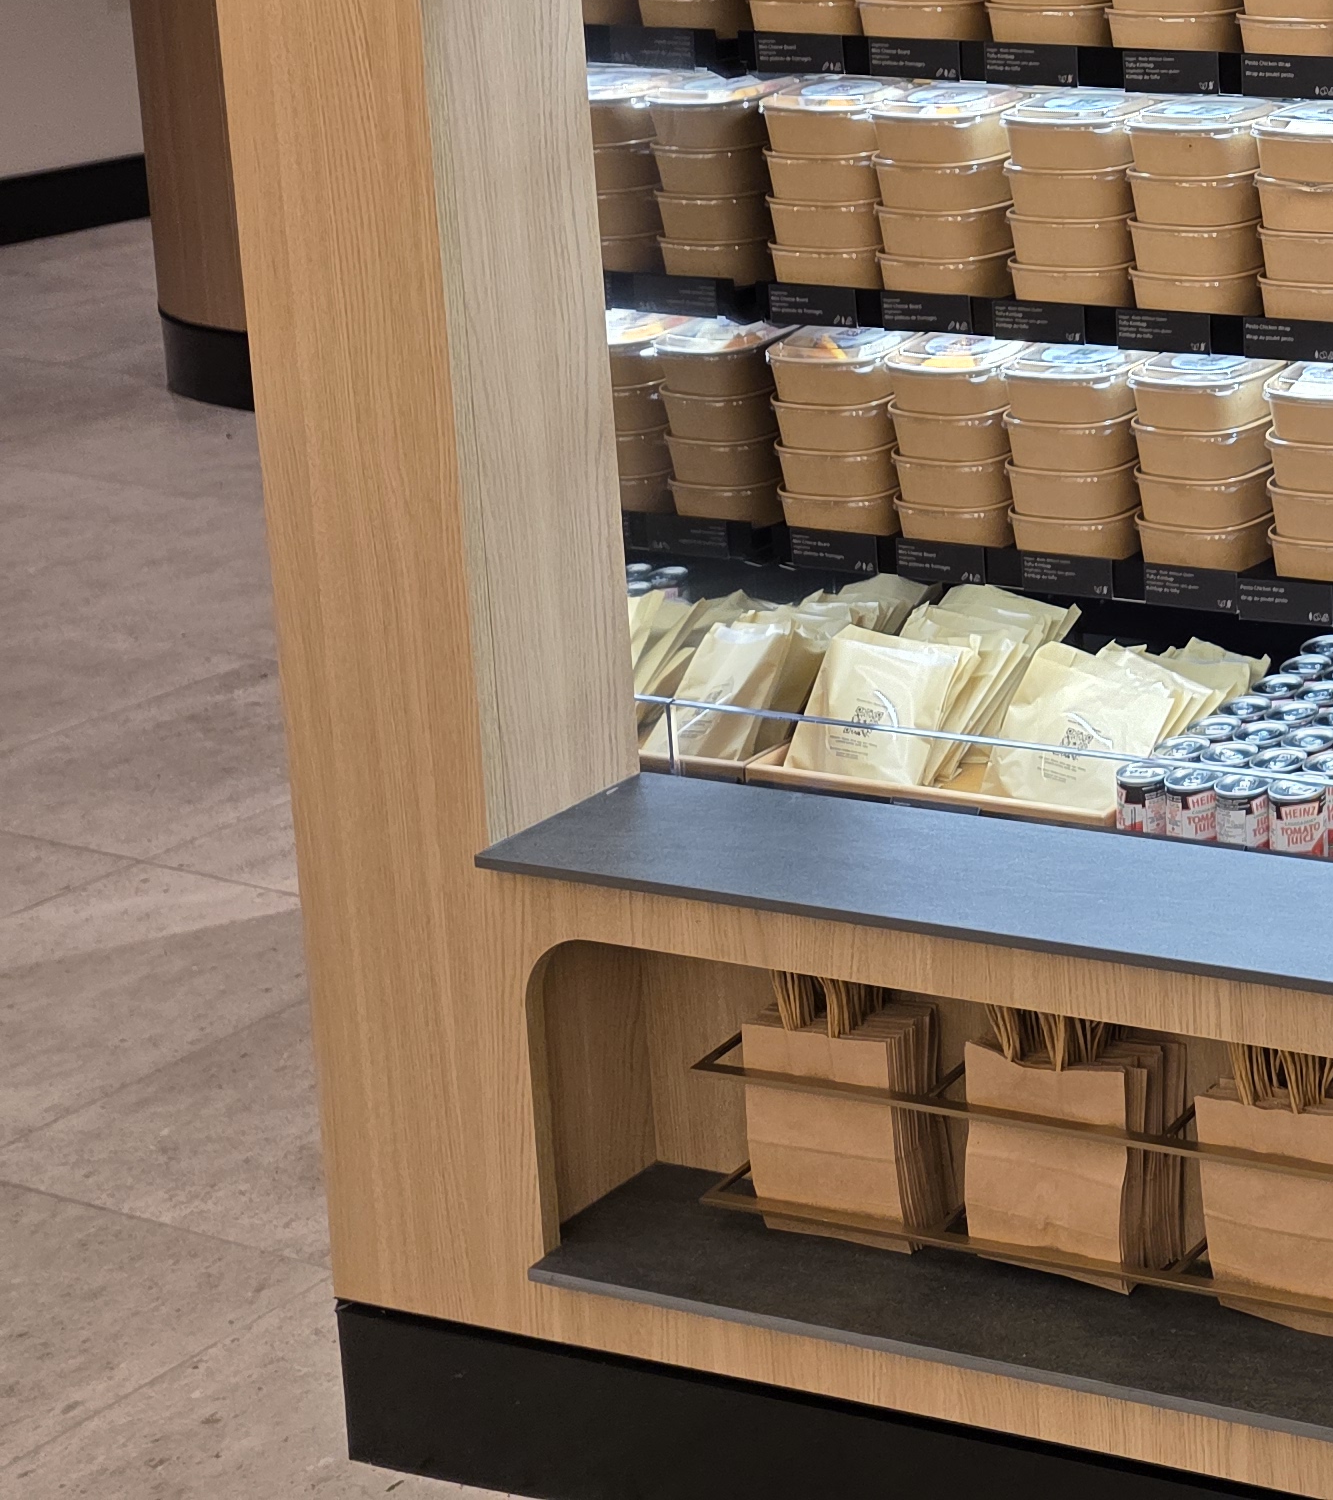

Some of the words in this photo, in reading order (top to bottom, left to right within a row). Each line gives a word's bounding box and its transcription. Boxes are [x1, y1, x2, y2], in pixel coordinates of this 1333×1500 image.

[1192, 794, 1216, 808] HEIN
[1285, 806, 1316, 819] HEINZ
[1281, 822, 1320, 836] TOMATO
